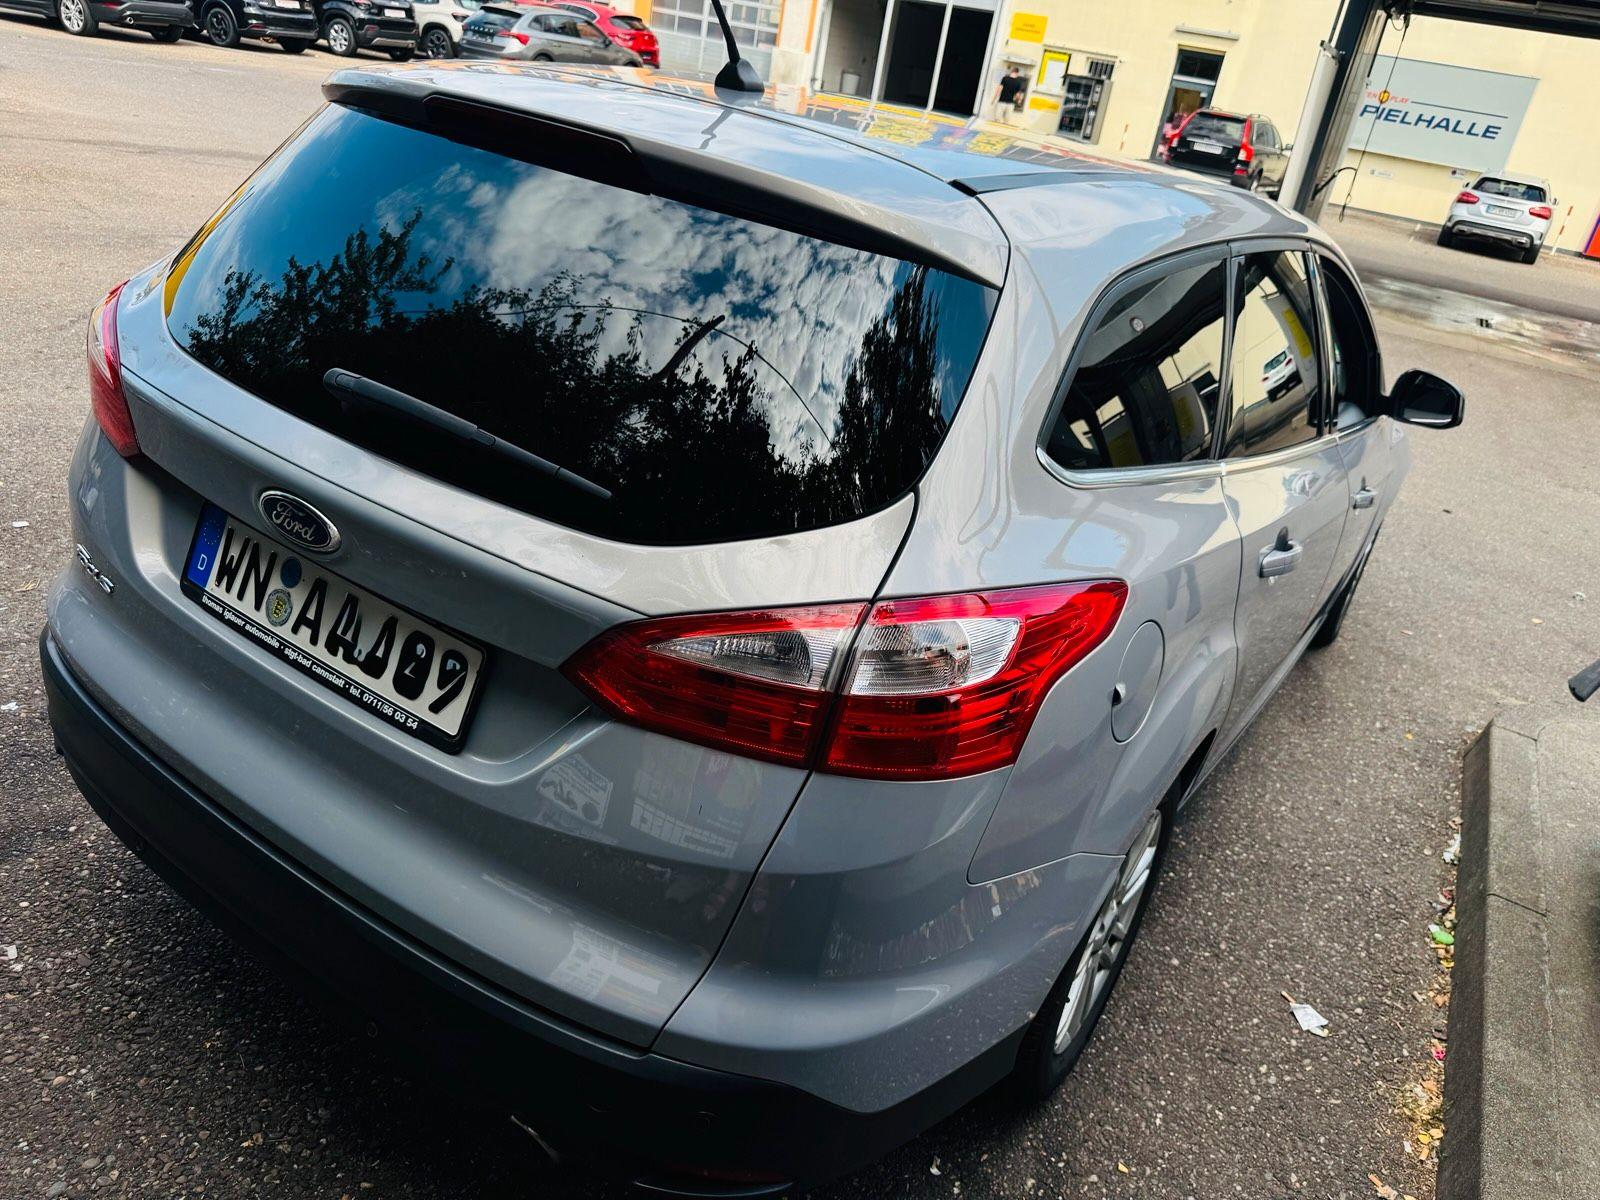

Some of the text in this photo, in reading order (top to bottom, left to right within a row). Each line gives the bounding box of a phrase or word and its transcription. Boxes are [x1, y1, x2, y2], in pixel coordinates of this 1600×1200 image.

[272, 502, 315, 541] Ford
[197, 554, 208, 571] D
[215, 525, 277, 611] WN
[202, 595, 223, 614] thomas
[223, 608, 245, 627] iglauer
[245, 623, 280, 648] automobile
[311, 664, 345, 688] cannstatt
[349, 685, 361, 698] tel.
[362, 693, 393, 716] 0711/56
[394, 712, 406, 723] 03
[406, 718, 419, 730] 54
